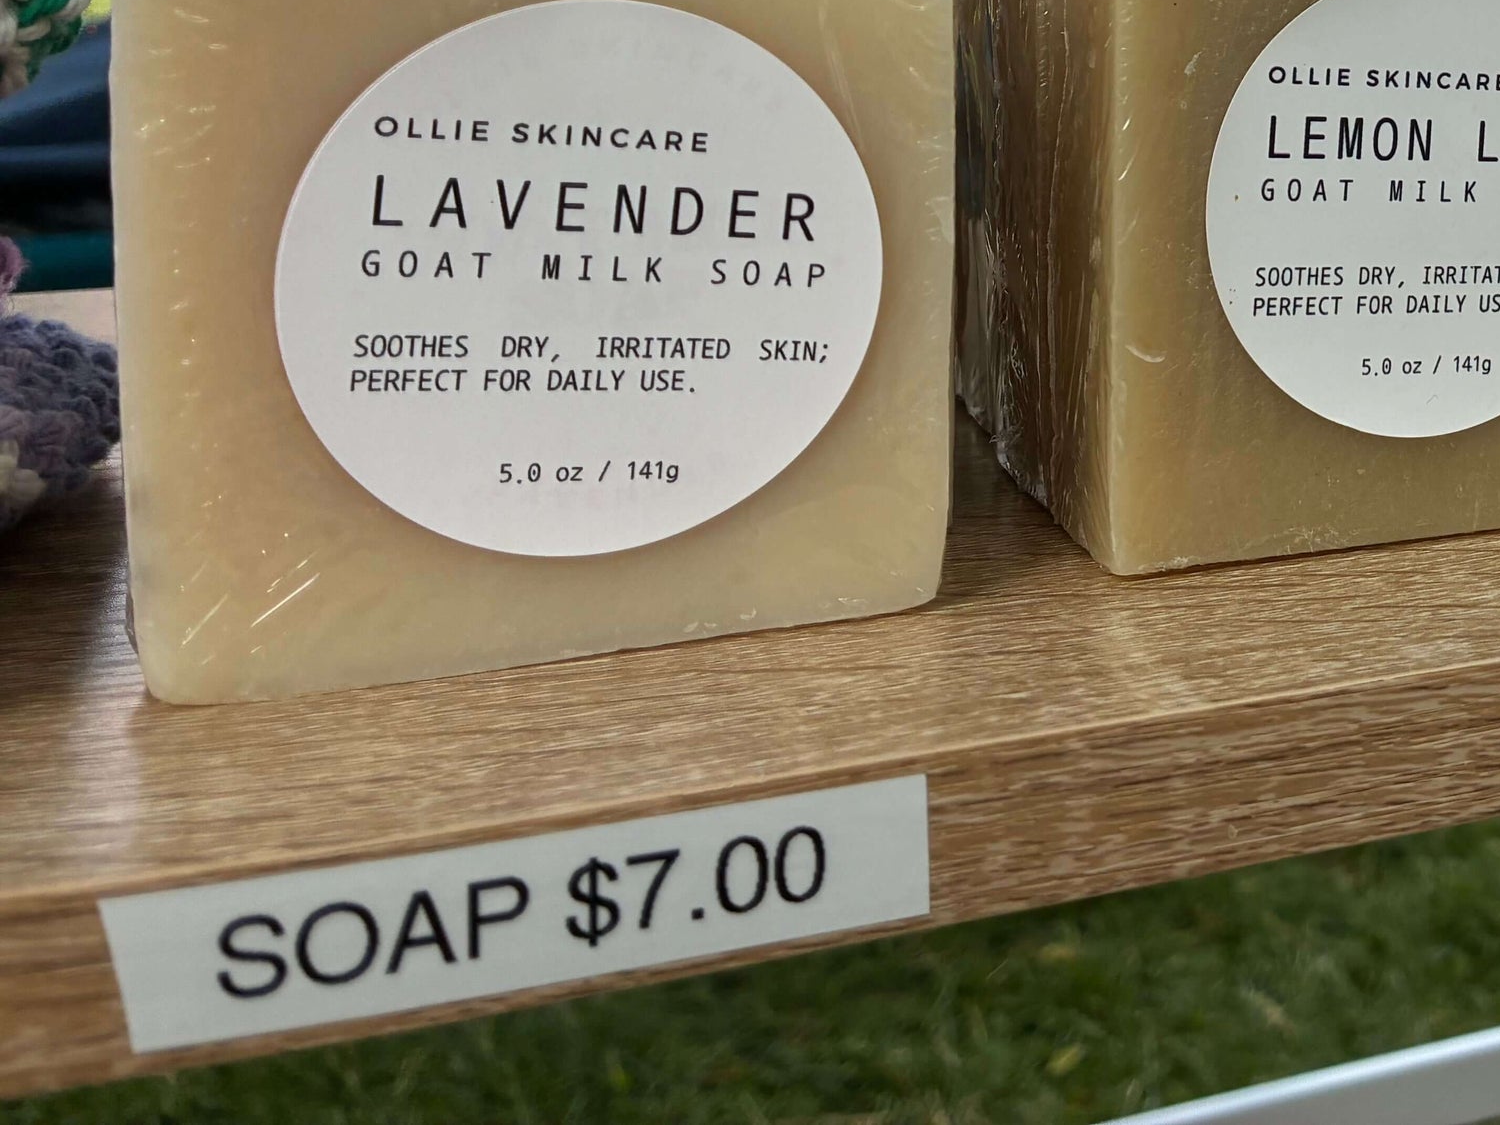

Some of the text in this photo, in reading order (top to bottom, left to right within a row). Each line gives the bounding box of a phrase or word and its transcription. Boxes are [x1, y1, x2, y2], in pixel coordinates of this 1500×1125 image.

[1268, 65, 1351, 87] OLLIE
[373, 115, 709, 153] OLLIE SKINCARE
[1267, 114, 1433, 162] LEMON
[1260, 177, 1354, 202] GOAT
[1388, 179, 1477, 203] MILK
[371, 174, 815, 242] LAVENDER
[361, 249, 826, 288] GOAT MILK SOAP
[1254, 266, 1344, 288] SOOTHES
[1358, 265, 1405, 289] DRY,
[1252, 295, 1344, 317] PERFECT
[1356, 295, 1393, 315] FOR
[1405, 294, 1467, 314] DAILY
[353, 334, 829, 364] SOOTHES DRY, IRRITATED SKIN;
[1361, 354, 1492, 377] 5.0 oz / 141g
[349, 368, 695, 393] PERFECT FOR DAILY USE.
[499, 460, 679, 485] 5.0 oz / 141g
[216, 825, 830, 1002] SOAP $7.00
